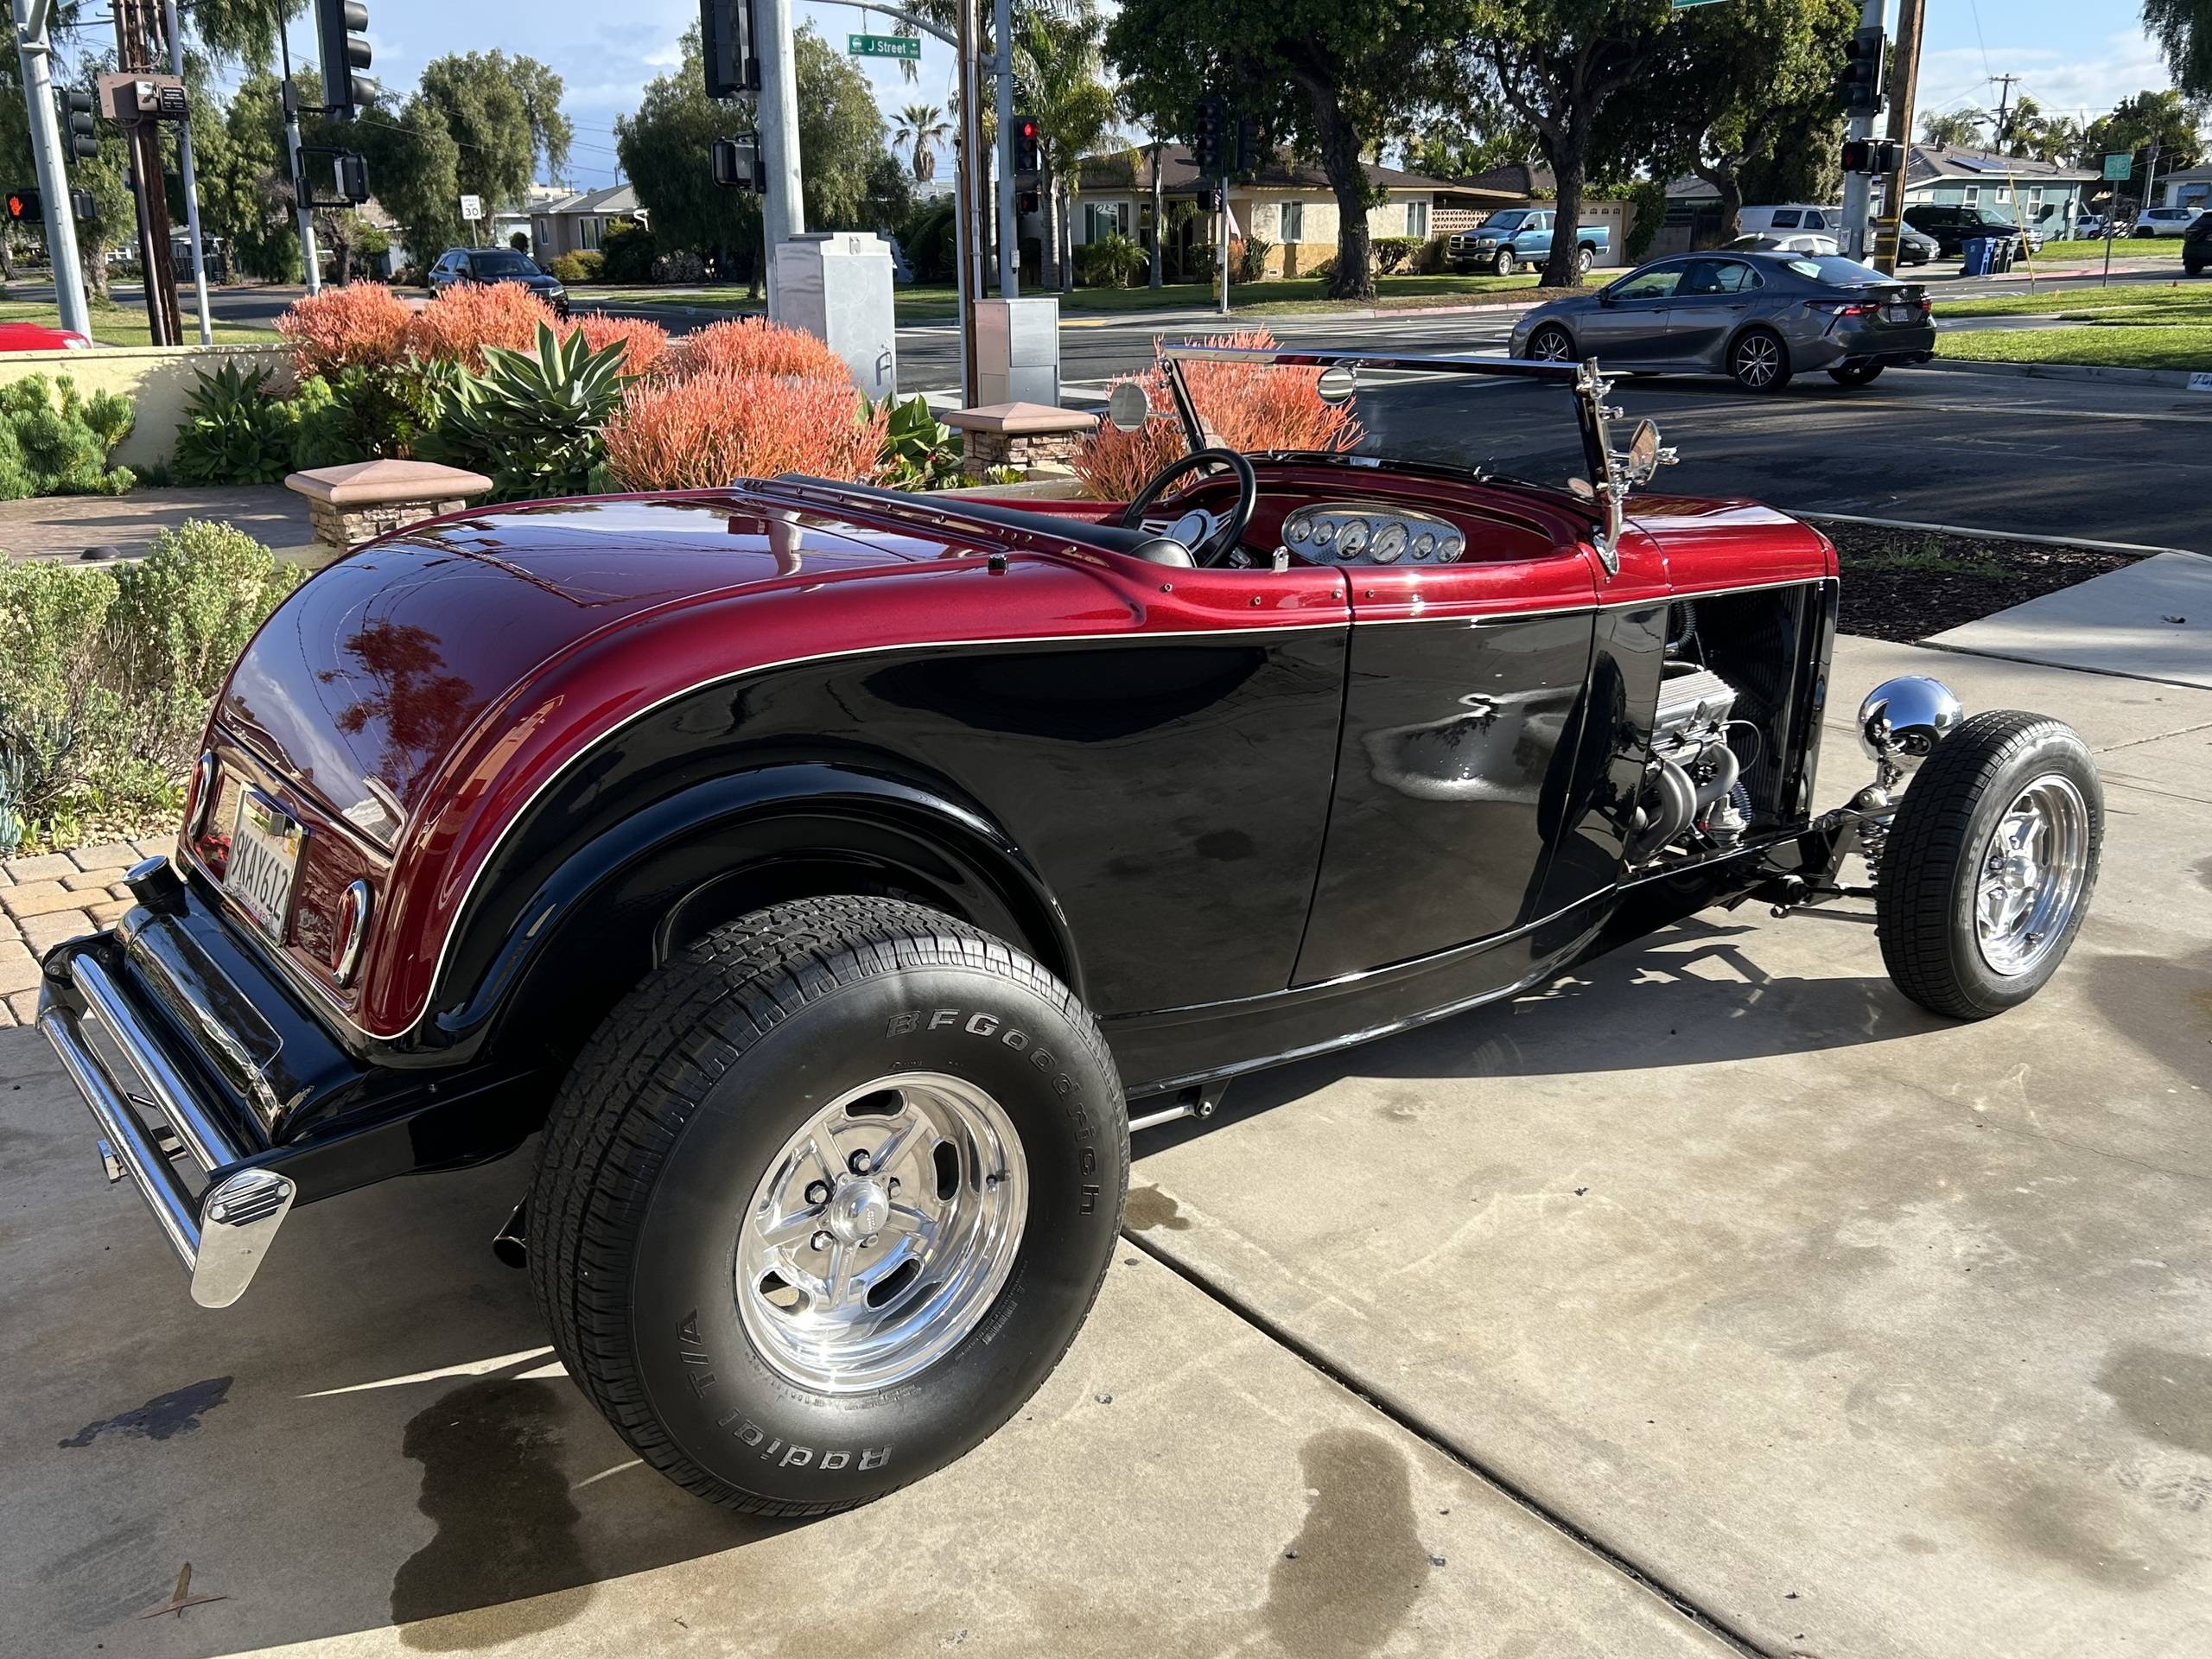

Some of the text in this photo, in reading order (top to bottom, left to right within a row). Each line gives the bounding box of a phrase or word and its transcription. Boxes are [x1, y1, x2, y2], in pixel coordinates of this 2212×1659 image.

[868, 40, 906, 54] J Street
[465, 207, 479, 216] 30
[232, 830, 288, 921] 9KAY612
[885, 1008, 1100, 1216] BFGoodrich
[677, 1307, 717, 1399] T/A
[717, 1408, 894, 1471] Radial
